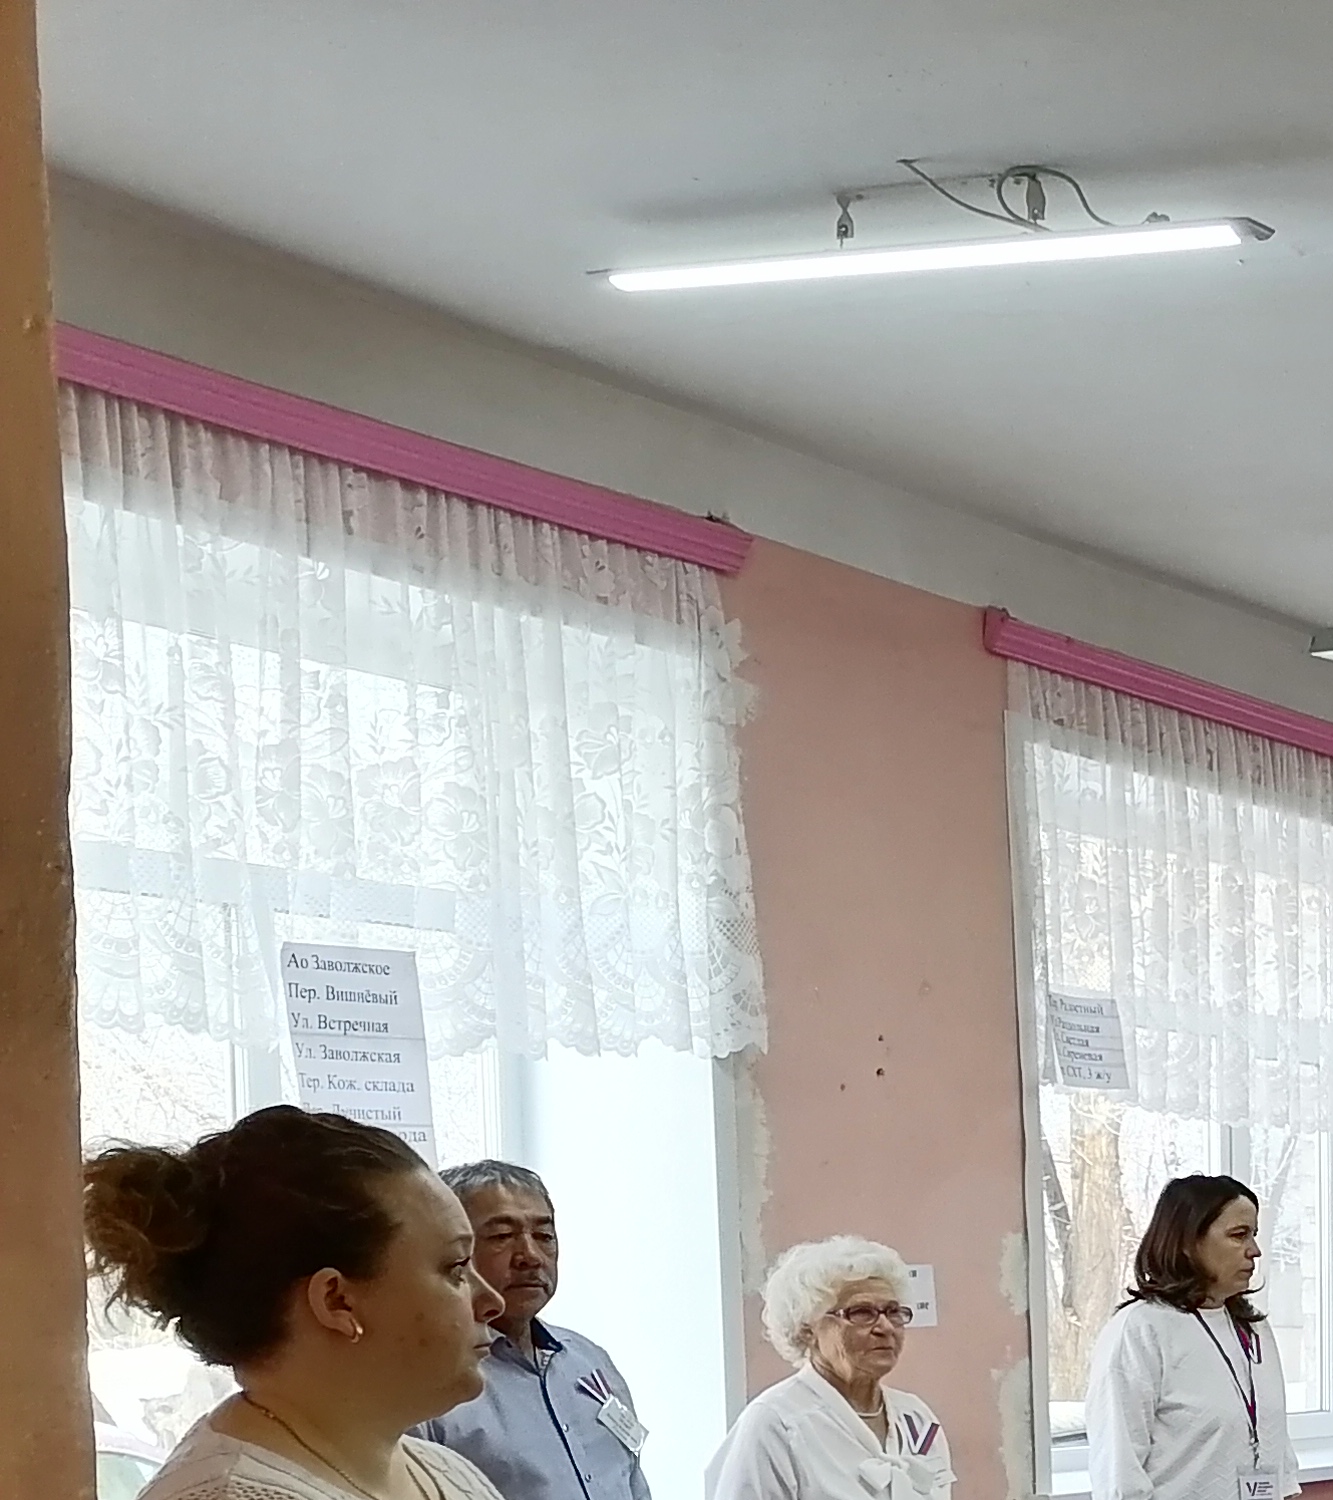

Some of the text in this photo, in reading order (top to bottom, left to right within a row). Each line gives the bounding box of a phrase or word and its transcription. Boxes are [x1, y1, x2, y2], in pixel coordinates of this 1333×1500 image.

[312, 954, 391, 976] Заволжское
[287, 982, 398, 1005] Пер. Вишнёвый
[291, 1012, 389, 1035] Ул. Встречная
[295, 1042, 401, 1064] Ул. Заволжская
[327, 1074, 360, 1090] Кож.
[364, 1079, 415, 1093] склада
